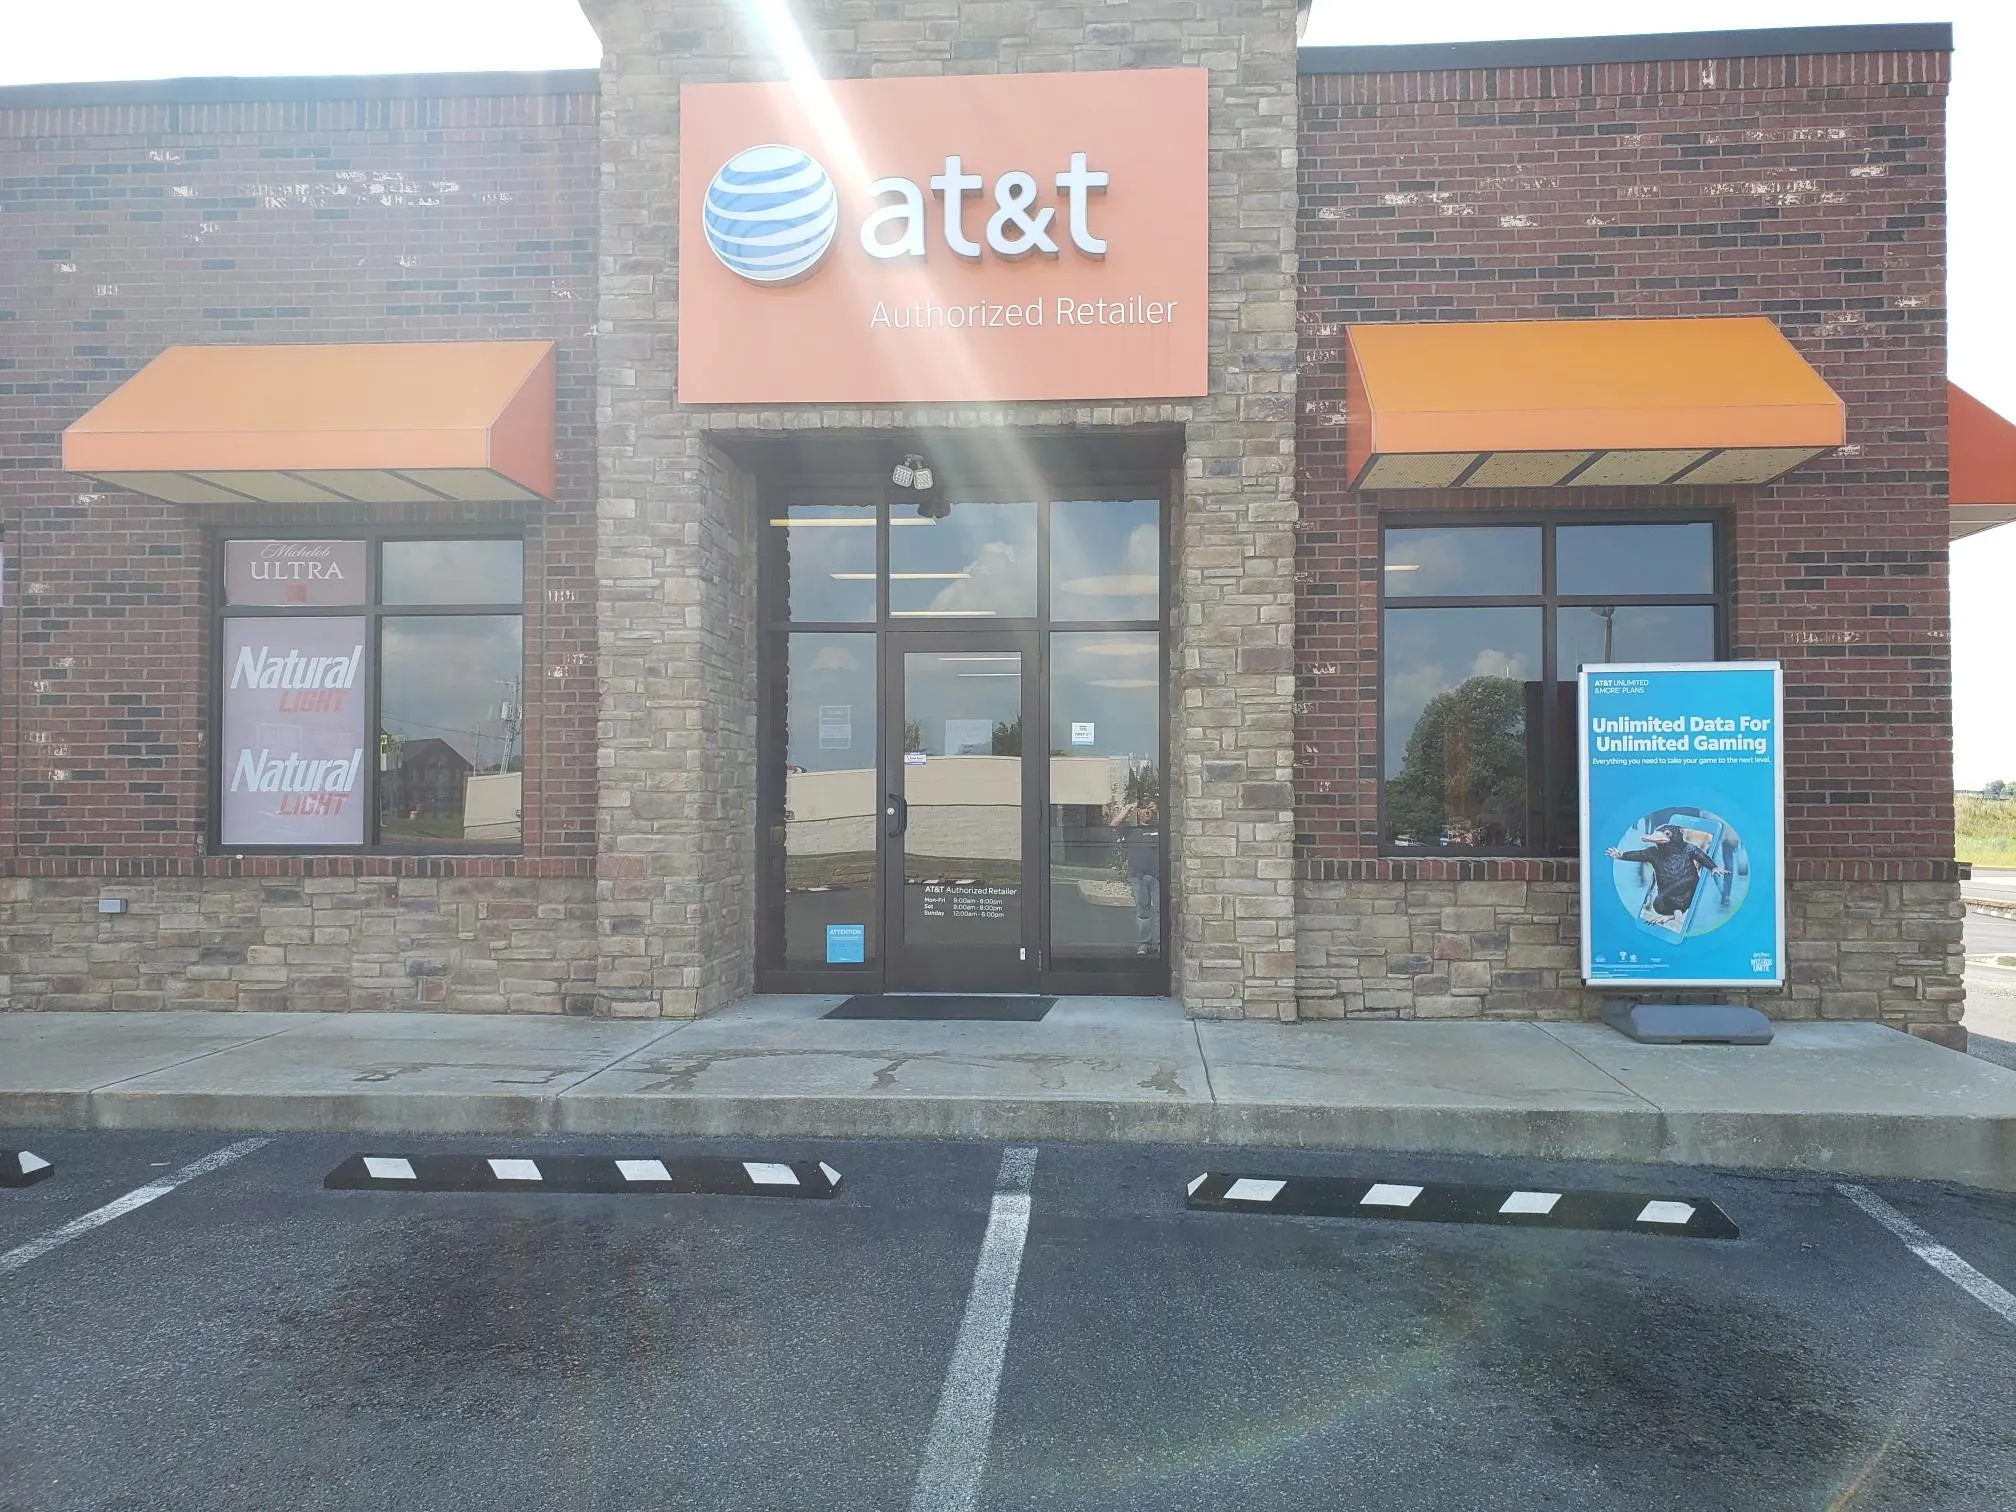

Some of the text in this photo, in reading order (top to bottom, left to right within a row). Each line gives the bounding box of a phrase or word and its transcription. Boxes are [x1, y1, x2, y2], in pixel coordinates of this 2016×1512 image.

[860, 152, 1108, 260] at&t
[870, 295, 1178, 328] Authorized Retailer
[260, 544, 330, 559] Michelob
[250, 561, 344, 580] ULTRA
[230, 645, 363, 689] Natural
[1594, 679, 1649, 687] AT&T UNLIMITED
[278, 691, 349, 713] LIGHT
[1592, 716, 1770, 733] Unlimited Data For
[1596, 734, 1767, 754] Unlimited Gaming
[230, 749, 363, 792] Natural
[1592, 758, 1627, 766] Everything
[1642, 757, 1658, 765] need
[1667, 757, 1681, 765] take
[1699, 758, 1718, 766] game
[279, 793, 350, 816] LIGHT
[924, 885, 1017, 895] AT&T Authorized Retailer
